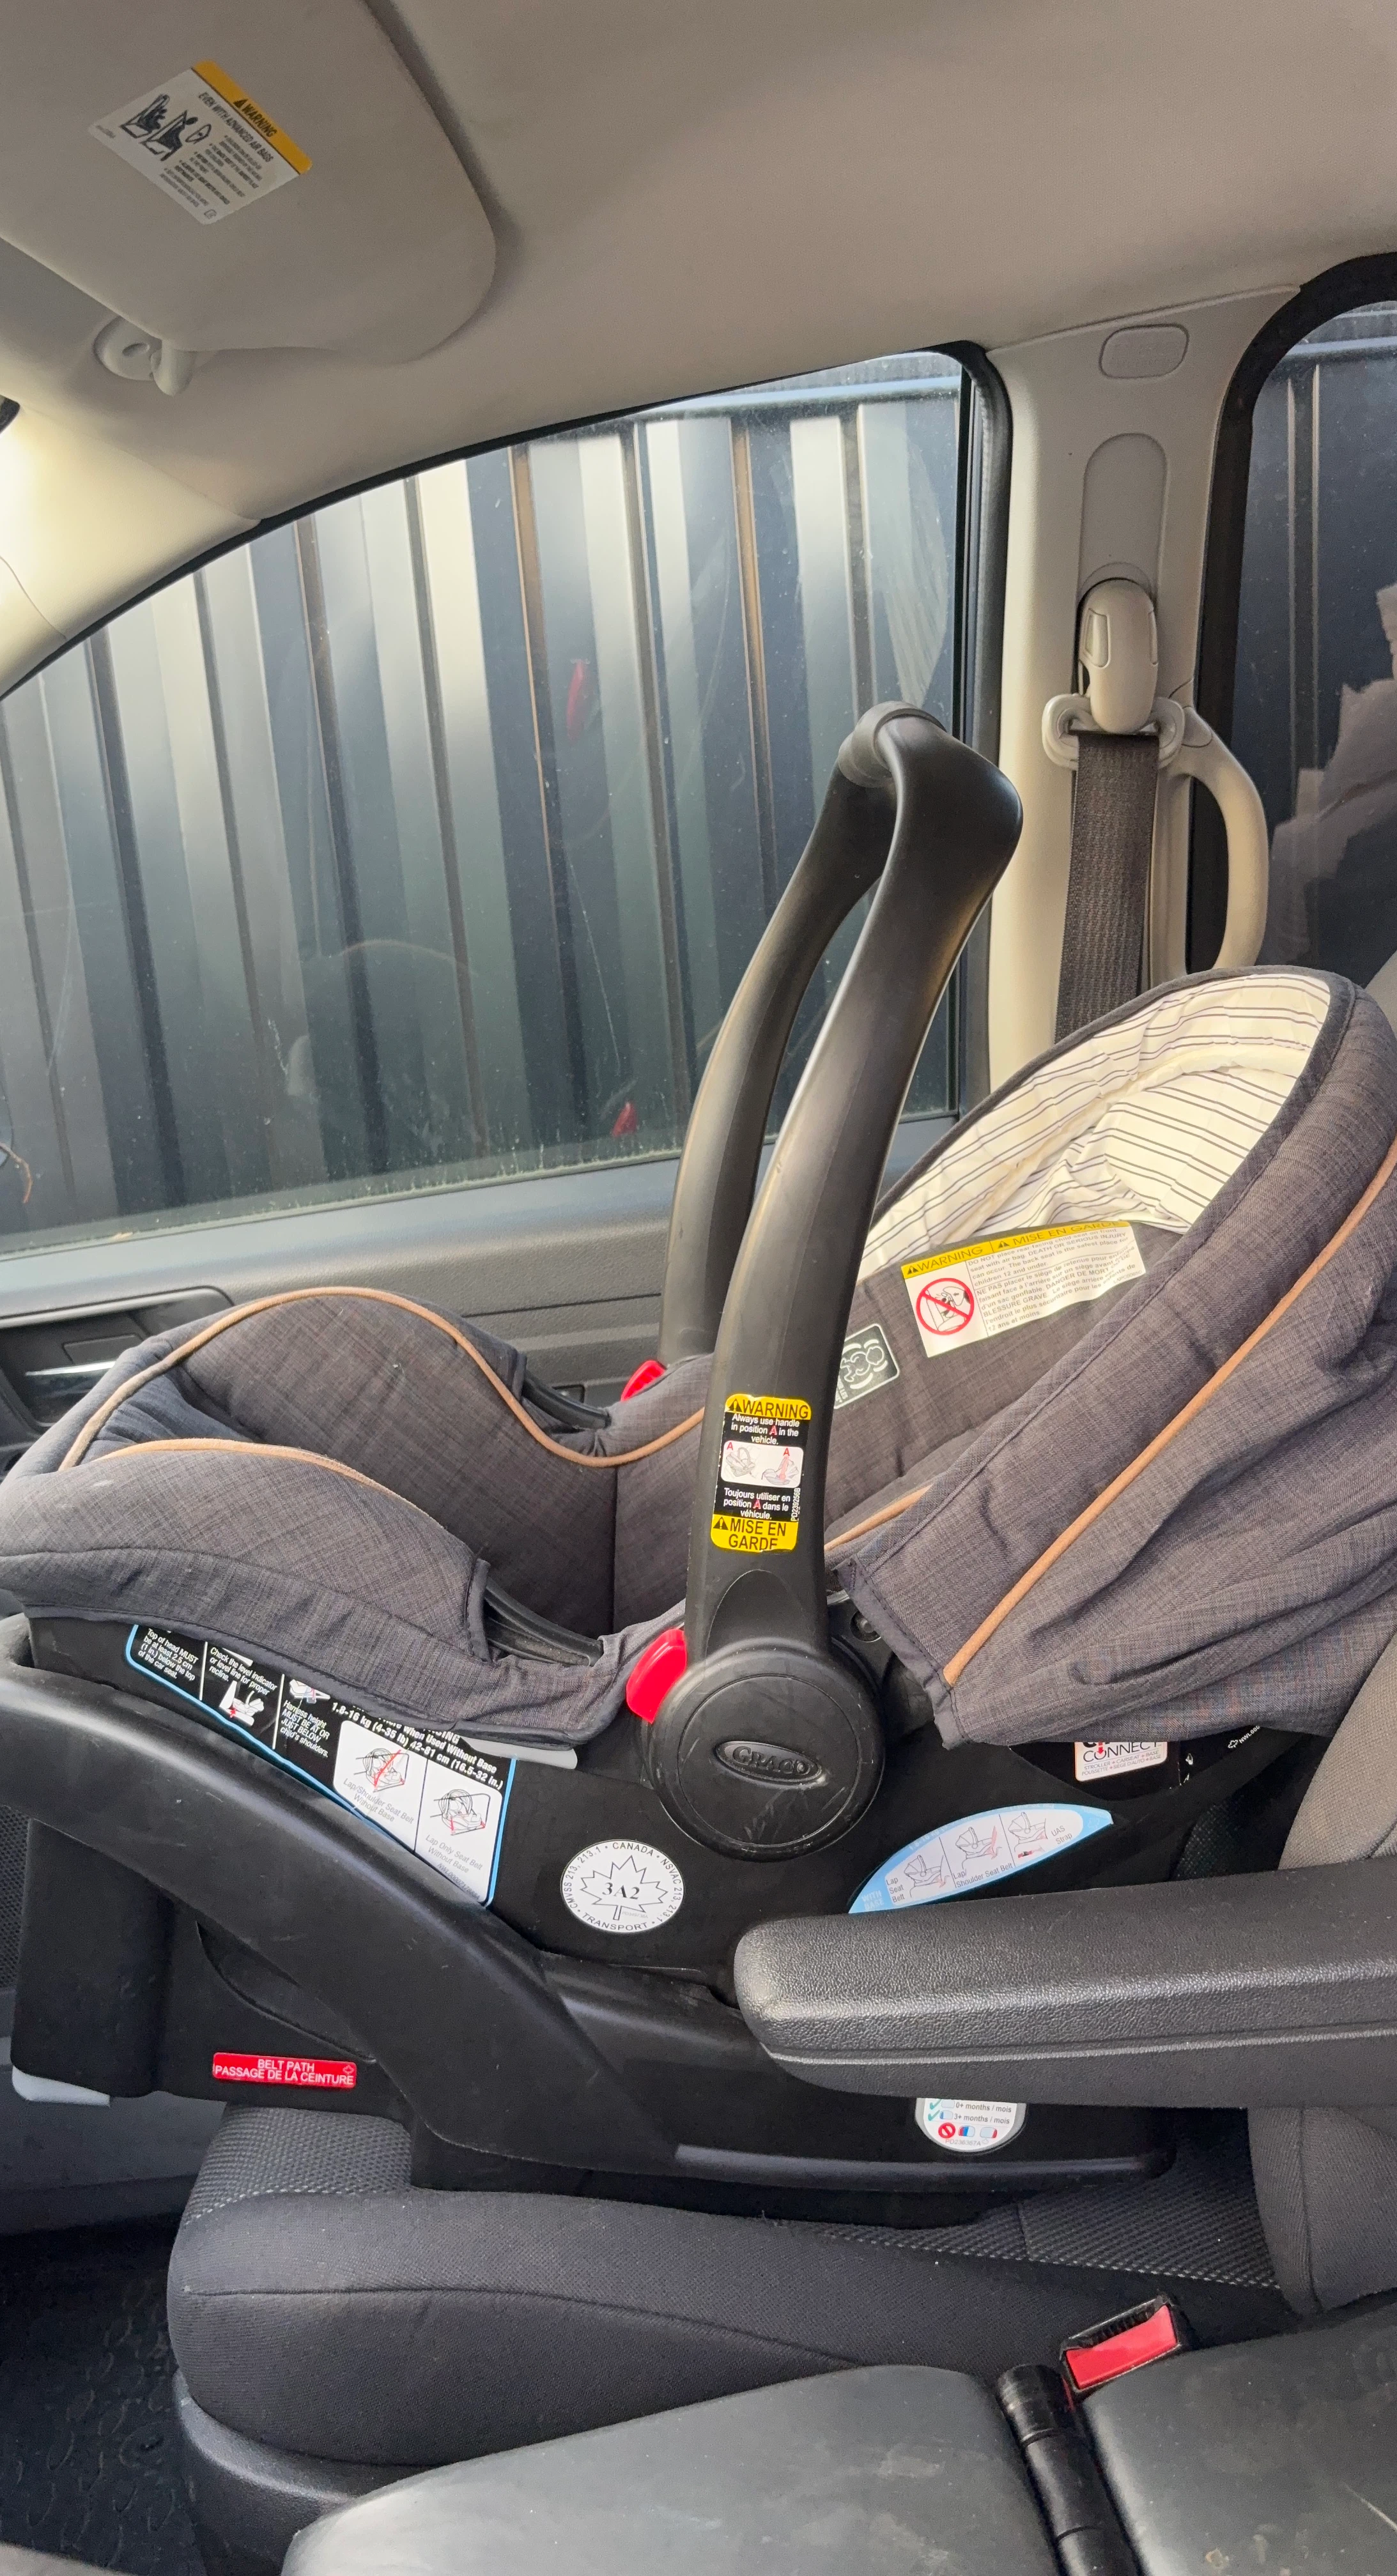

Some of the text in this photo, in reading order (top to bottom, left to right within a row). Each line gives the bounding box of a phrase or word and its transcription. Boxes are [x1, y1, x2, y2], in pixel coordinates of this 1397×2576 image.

[199, 92, 217, 107] EVEN
[212, 104, 229, 119] WITH
[226, 118, 254, 142] ADVANCED
[249, 141, 261, 151] AIR
[257, 148, 274, 162] BAGS
[242, 103, 277, 137] WARNING
[1012, 1232, 1045, 1246] MISE
[1049, 1228, 1067, 1237] EN
[917, 1247, 983, 1271] WARNING
[975, 1275, 1002, 1286] children
[1004, 1275, 1024, 1286] placer
[1046, 1275, 1075, 1289] DANGER
[983, 1299, 1021, 1317] BLESSURE
[743, 1400, 808, 1419] WARNING
[732, 1414, 758, 1424] Always
[775, 1418, 799, 1427] handle
[739, 1425, 768, 1435] position
[769, 1426, 777, 1436] A
[727, 1442, 734, 1450] A
[751, 1436, 778, 1445] vehicle.
[783, 1448, 790, 1456] A
[723, 1498, 752, 1508] position
[724, 1488, 754, 1499] Toujours
[756, 1492, 780, 1501] utiliser
[741, 1509, 772, 1520] véhicule.
[730, 1518, 786, 1536] MISE EN
[729, 1534, 778, 1550] GARDE
[143, 1635, 192, 1670] be at least 2.5 cm
[147, 1629, 198, 1664] Top of head MUST
[137, 1649, 146, 1658] of
[144, 1653, 154, 1663] the
[153, 1660, 164, 1670] car
[141, 1643, 148, 1651] (1
[158, 1653, 176, 1668] below
[175, 1664, 185, 1674] the
[185, 1671, 195, 1681] top
[210, 1646, 277, 1691] Check the level indicator
[209, 1657, 270, 1697] or level line for proper
[282, 1708, 330, 1739] MUST BE AT OR
[307, 1713, 327, 1729] height
[280, 1726, 300, 1740] child's
[281, 1718, 321, 1743] JUST BELOW
[331, 1702, 360, 1721] 1.8-16
[359, 1715, 371, 1728] kg
[372, 1722, 396, 1740] (4-35
[396, 1733, 409, 1746] lb)
[409, 1738, 435, 1758] 42-81
[436, 1753, 450, 1765] cm
[450, 1758, 488, 1782] (16.5-32
[487, 1775, 503, 1790] in.)
[403, 1724, 425, 1740] When
[425, 1733, 446, 1750] Used
[446, 1744, 477, 1765] Without
[476, 1758, 497, 1774] Base
[1083, 1742, 1157, 1763] CONNECT
[733, 1746, 810, 1775] GRACO
[1084, 1761, 1111, 1770] STROLLER
[1116, 1754, 1139, 1763] CARSEAT
[1082, 1767, 1108, 1775] POUSSETTE
[343, 1777, 413, 1823] Lap/Shoulder Seat Belt
[353, 1793, 394, 1822] Without Base
[1051, 1825, 1065, 1836] UAS
[1056, 1832, 1072, 1844] Strap
[425, 1834, 482, 1870] Lap Only Seat Belt
[612, 1842, 653, 1856] CANADA
[428, 1846, 469, 1873] Without Base
[660, 1859, 682, 1884] NSVAC
[953, 1869, 967, 1879] Lap/
[956, 1863, 1013, 1888] Shoulder Seat Belt
[602, 1882, 640, 1899] 3A2
[886, 1877, 898, 1886] Lap
[889, 1885, 904, 1894] Seat
[564, 1882, 578, 1908] CMVSS
[892, 1894, 905, 1903] Belt
[582, 1912, 648, 1931] TRANSPORT
[258, 2059, 315, 2072] BELT PATH
[215, 2066, 354, 2085] PASSAGE DE LA CEINTURE
